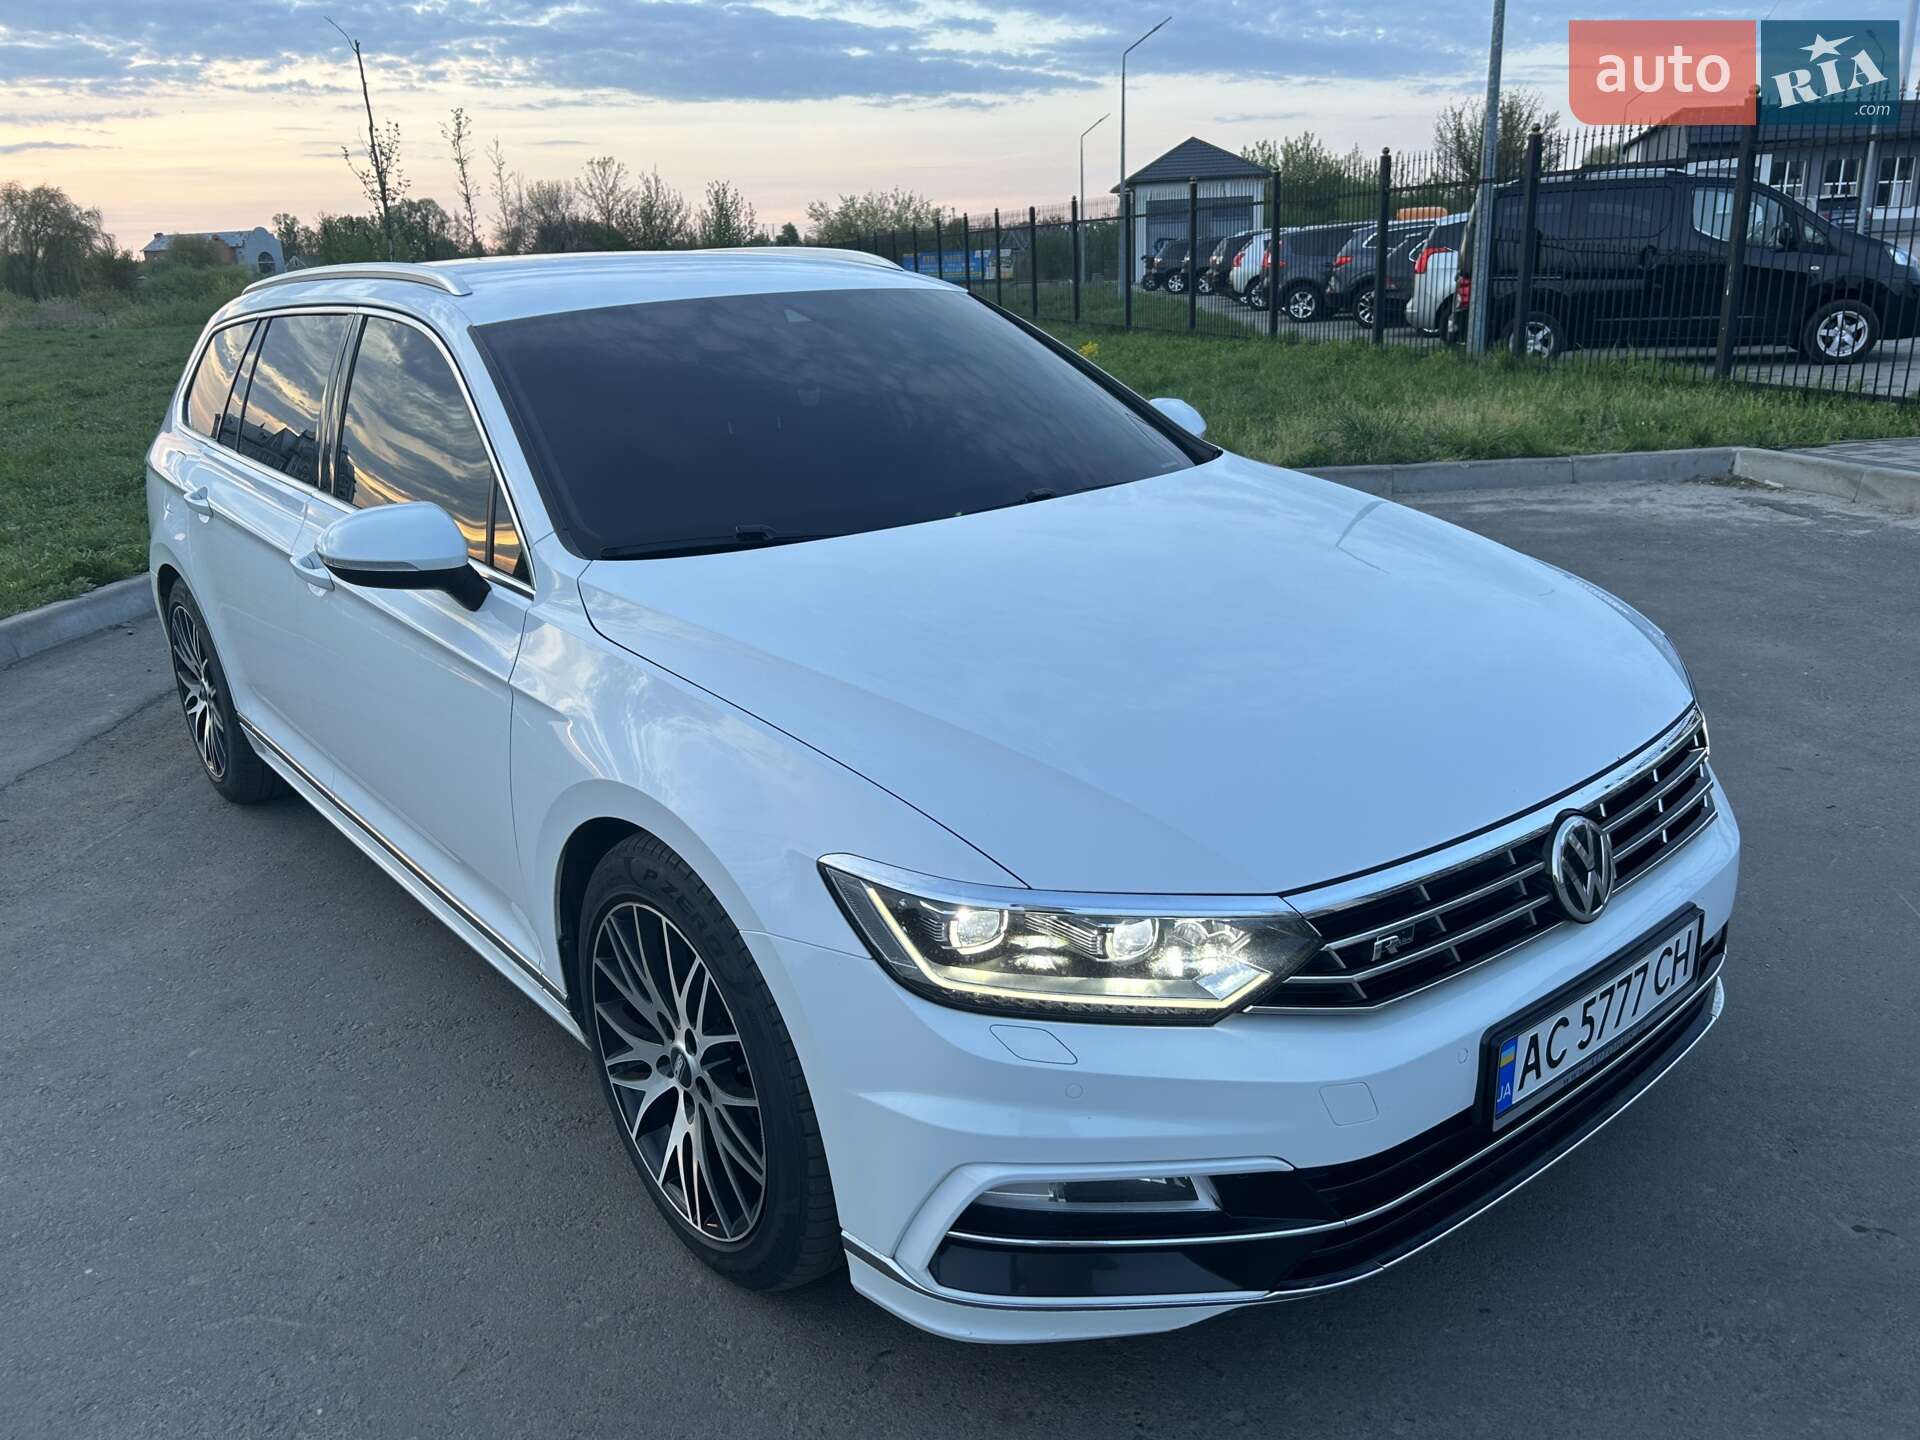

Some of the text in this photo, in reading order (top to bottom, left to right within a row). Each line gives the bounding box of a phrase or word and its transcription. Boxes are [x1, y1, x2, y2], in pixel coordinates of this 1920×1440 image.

[1518, 1017, 1570, 1092] AC
[1577, 961, 1650, 1051] 5777
[1654, 930, 1692, 996] CH
